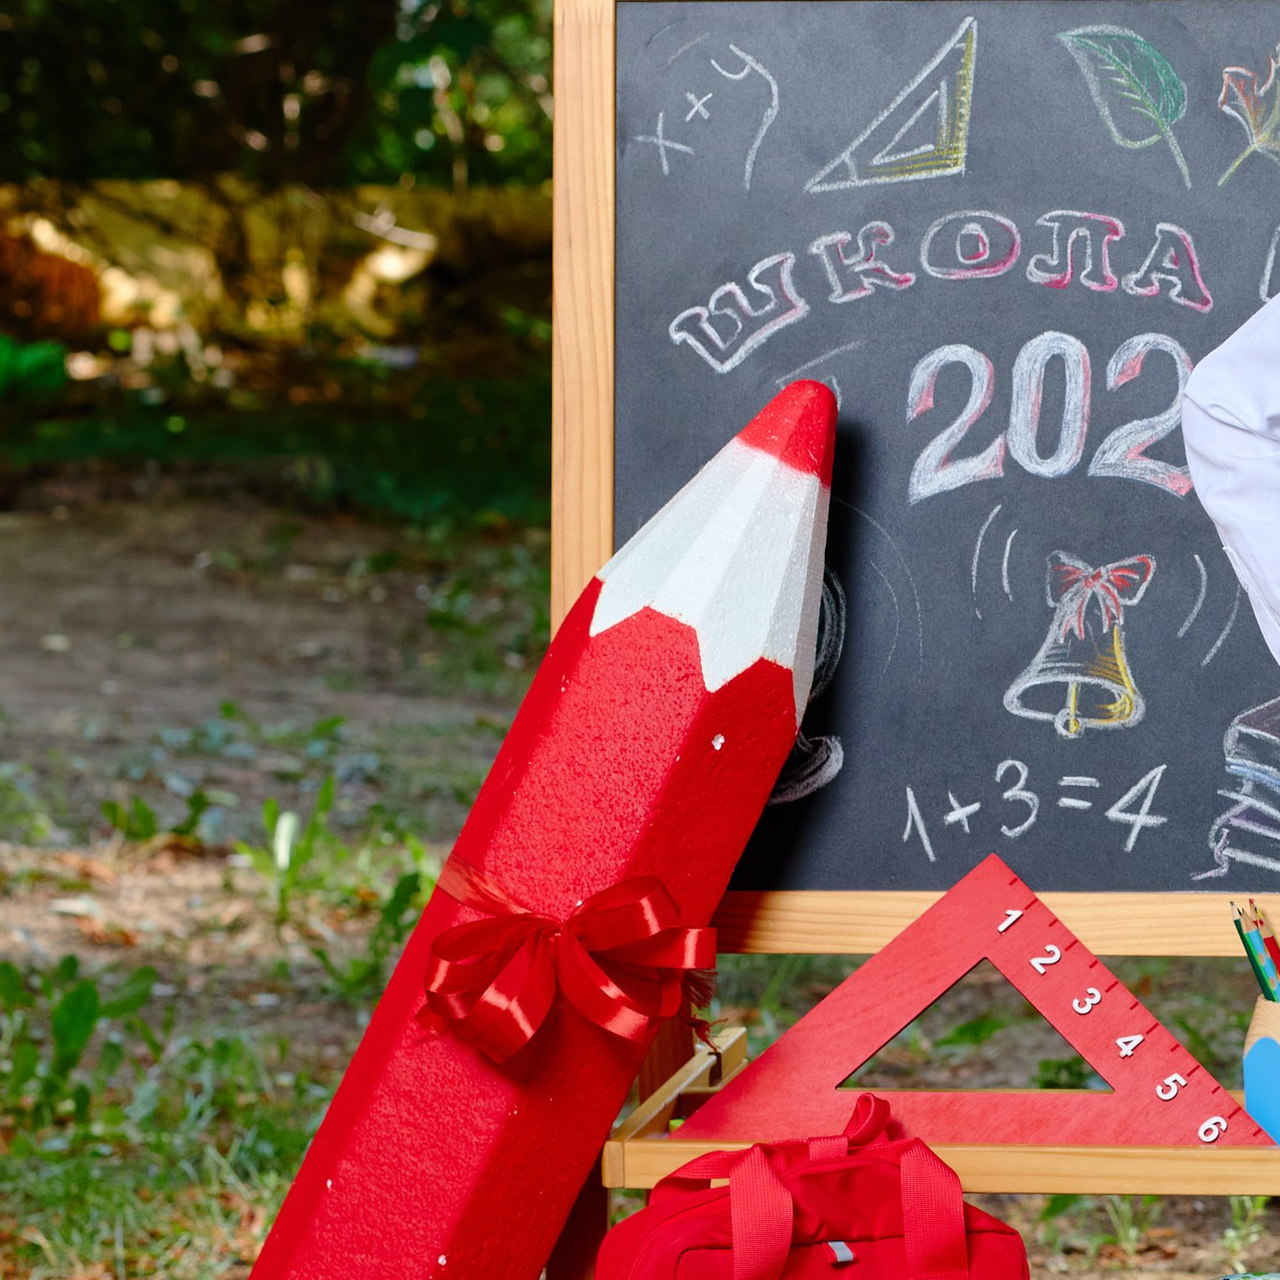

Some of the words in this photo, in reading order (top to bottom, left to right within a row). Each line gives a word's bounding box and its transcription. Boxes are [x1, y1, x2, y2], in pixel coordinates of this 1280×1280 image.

[668, 209, 1214, 375] ШКОЛА
[906, 329, 1194, 507] 202
[996, 908, 1024, 934] 1
[1028, 944, 1062, 976] 2
[1071, 986, 1102, 1016] 3
[1114, 1033, 1145, 1059] 4
[1155, 1072, 1188, 1101] 5
[1197, 1115, 1229, 1143] 6
